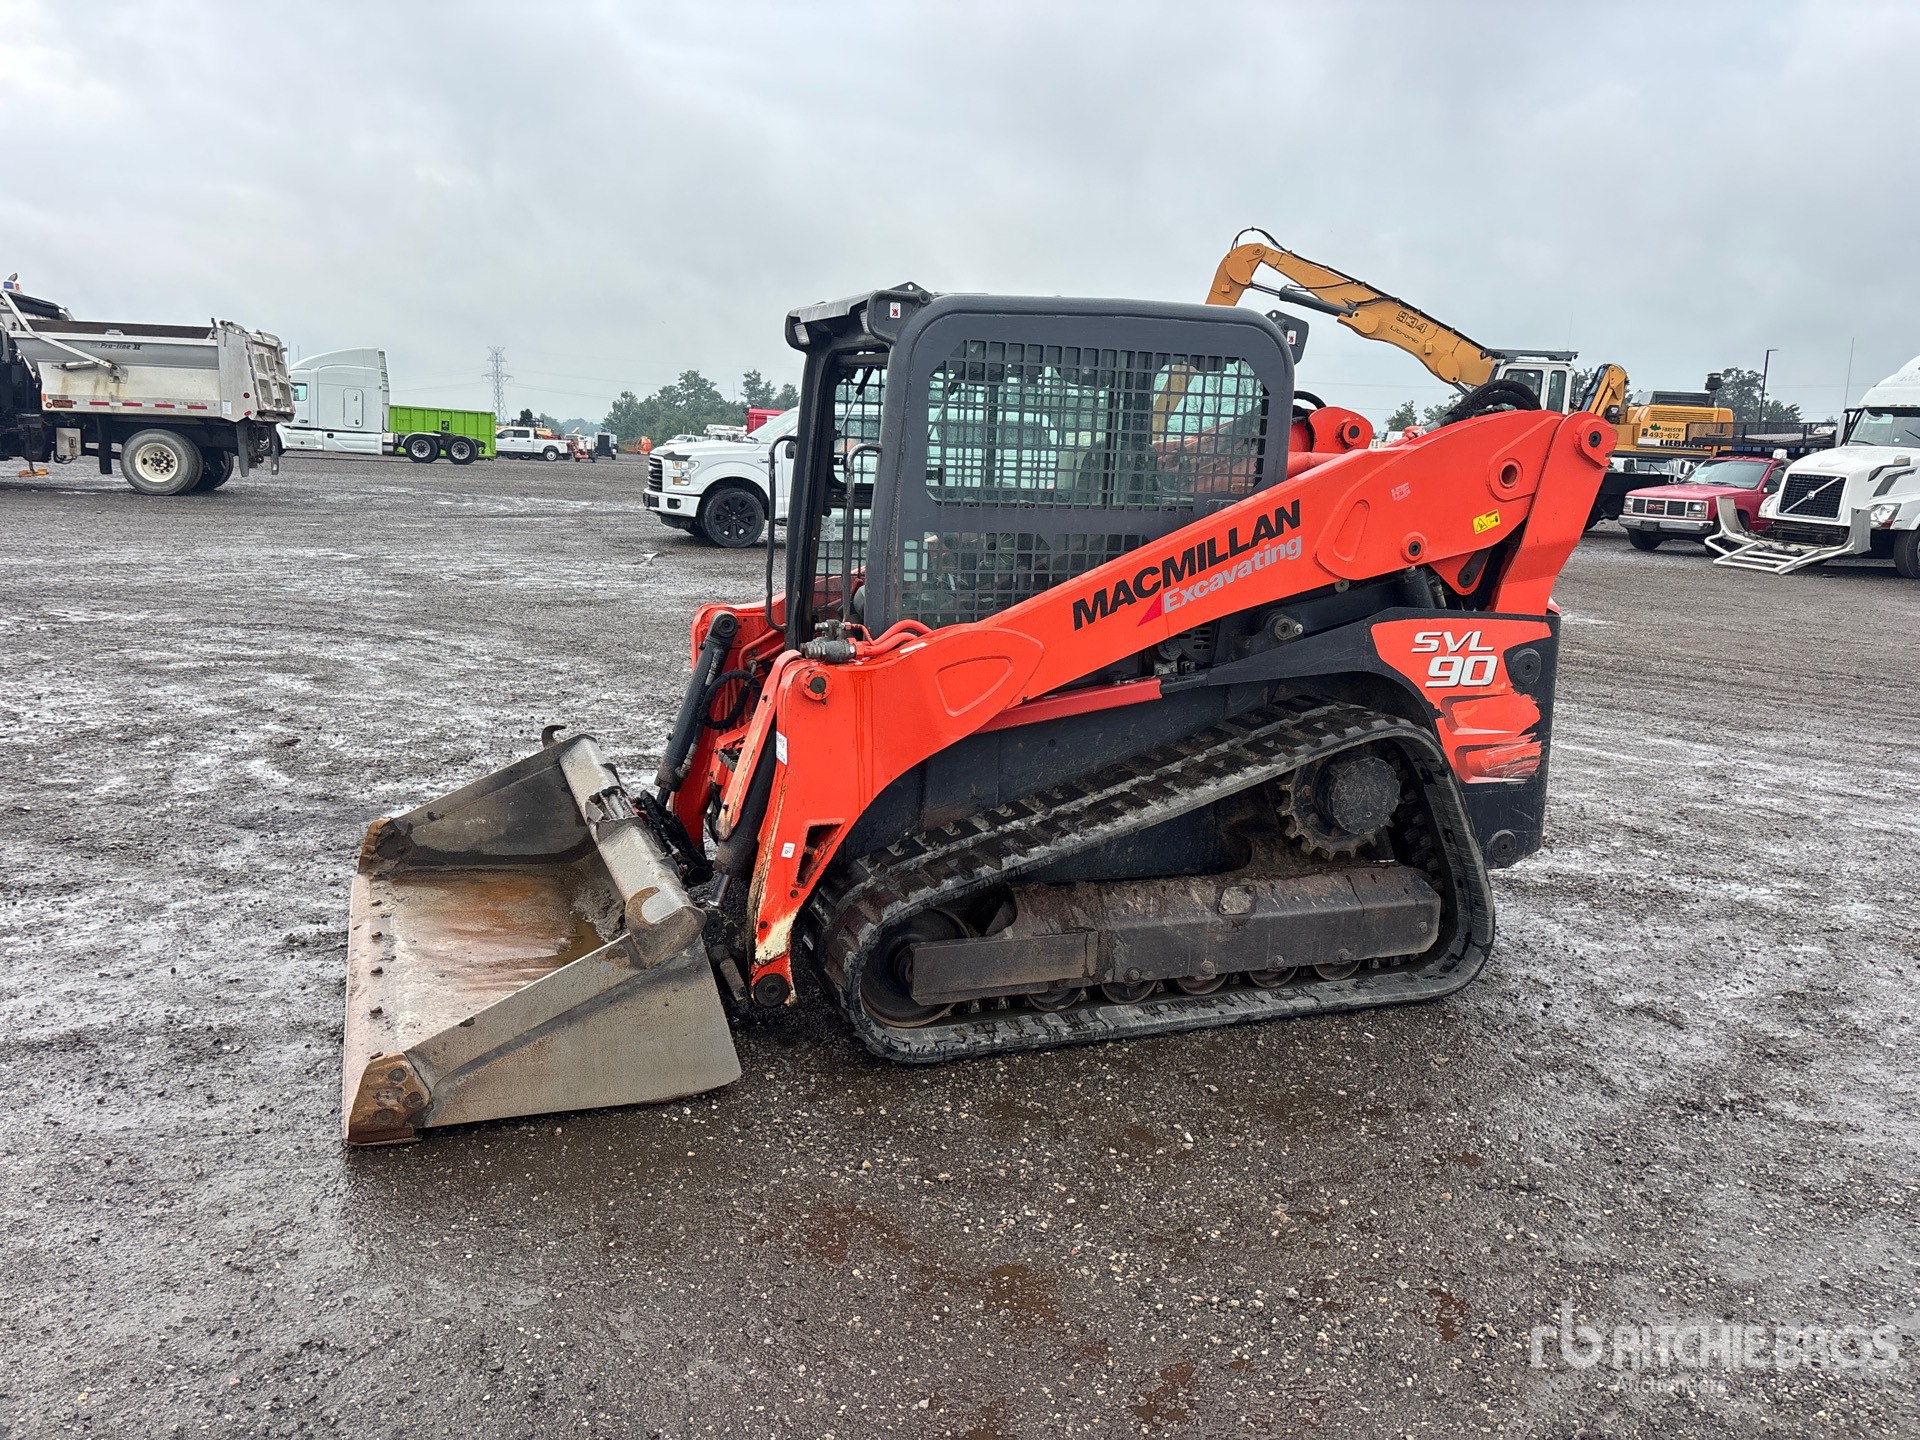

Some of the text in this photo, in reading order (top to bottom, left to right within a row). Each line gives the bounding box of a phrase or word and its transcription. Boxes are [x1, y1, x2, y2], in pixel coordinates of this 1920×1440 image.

[1396, 310, 1429, 334] 934
[1648, 431, 1681, 440] 493-612
[1072, 499, 1301, 631] MACMILLAN
[1162, 536, 1302, 614] Excavating
[1411, 630, 1495, 653] SVL
[1424, 655, 1499, 688] 90
